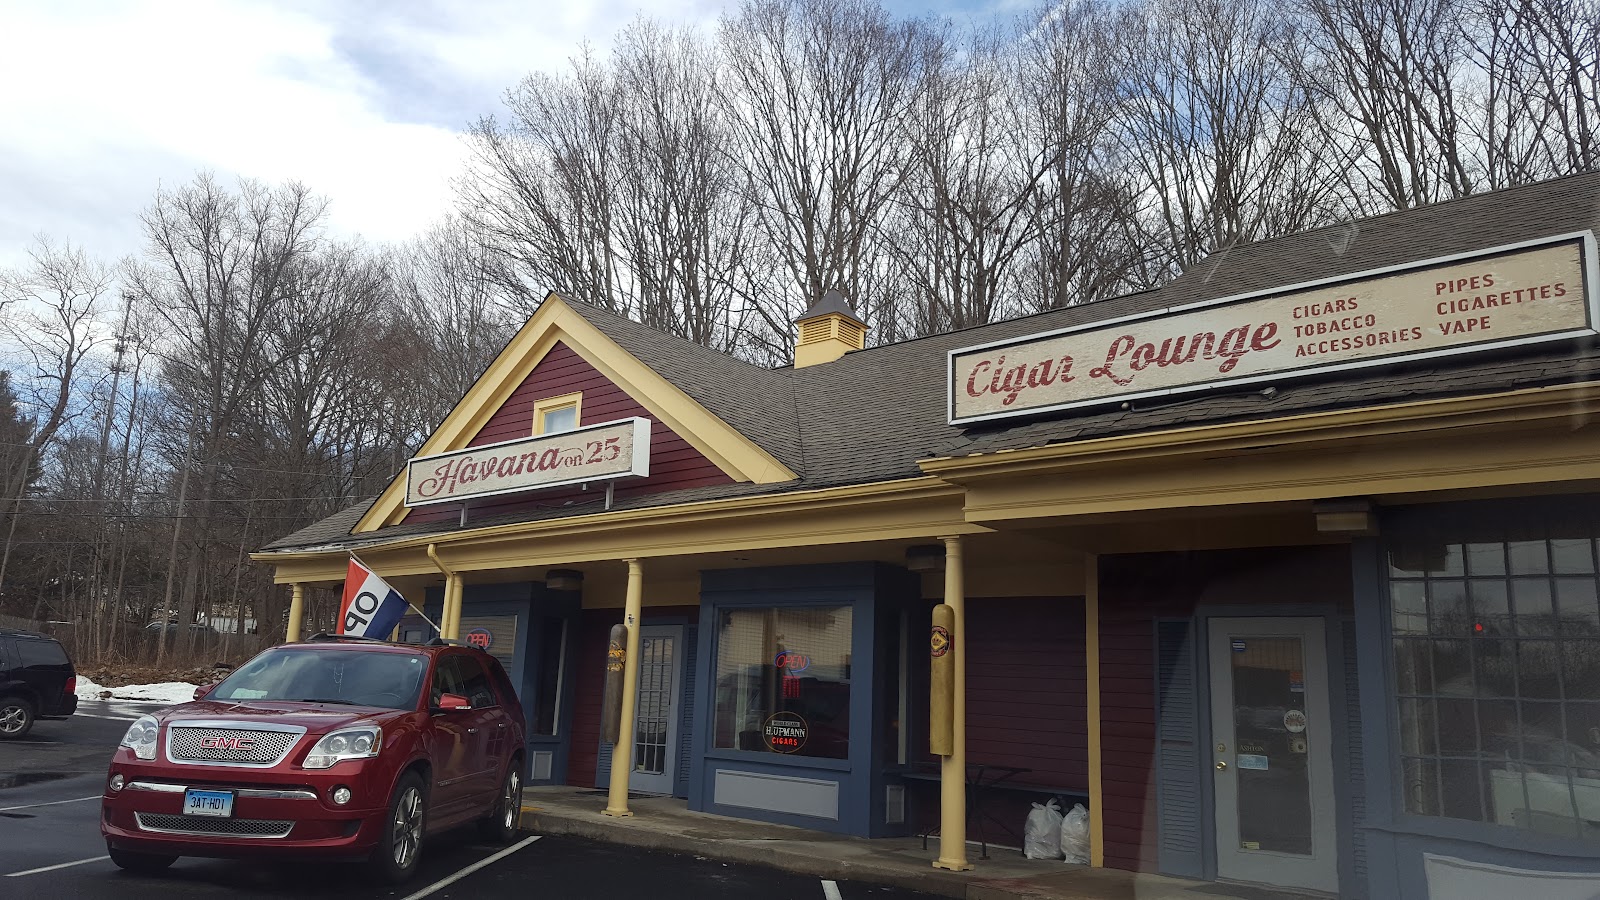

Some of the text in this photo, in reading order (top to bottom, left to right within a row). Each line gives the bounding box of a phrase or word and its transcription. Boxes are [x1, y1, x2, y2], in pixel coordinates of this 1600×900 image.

[1435, 274, 1495, 296] PIPES
[1292, 297, 1359, 320] CIGARS
[1436, 282, 1567, 316] CIGARETTES
[1294, 314, 1376, 339] TOBACCO
[1439, 315, 1491, 336] VAPE
[1295, 327, 1423, 358] ACCESSORIES
[966, 321, 1281, 406] Cigar Lounge
[417, 436, 621, 497] Havana on 25
[465, 633, 490, 647] OPEN
[776, 655, 807, 669] OPEN
[201, 736, 254, 751] GMC
[771, 736, 798, 746] CIGARS
